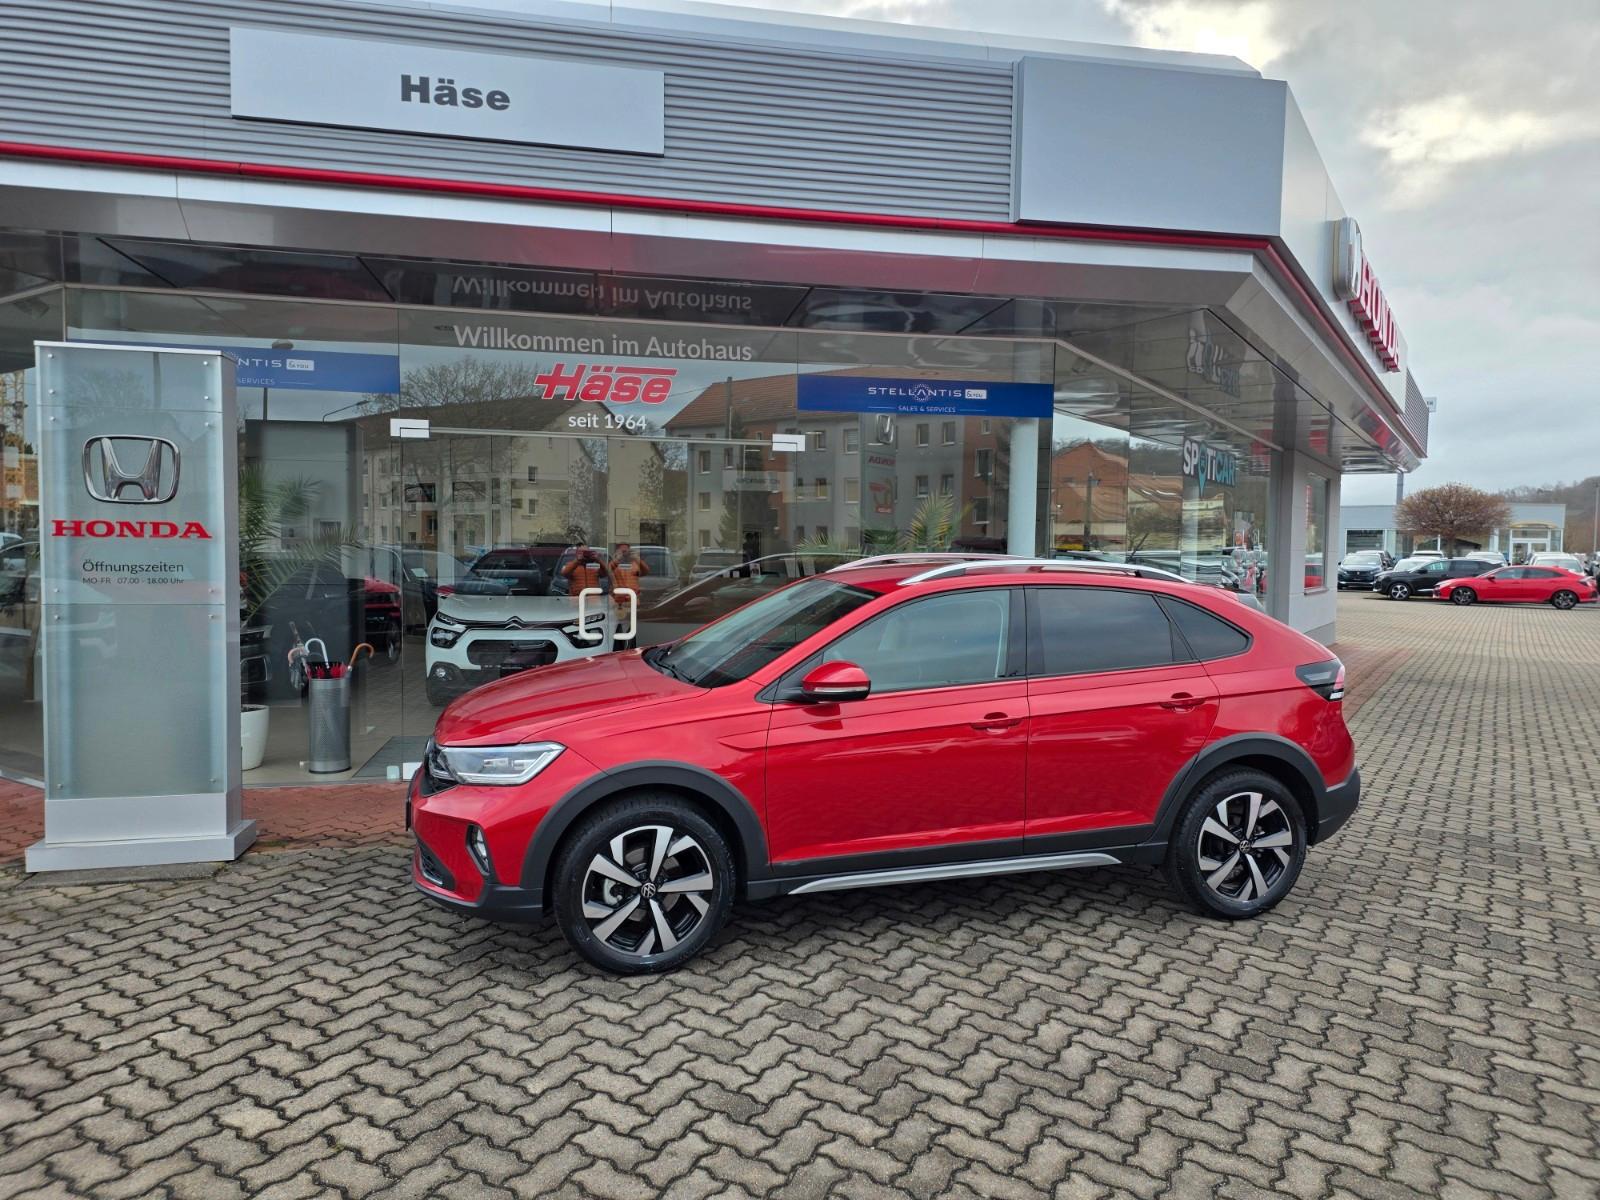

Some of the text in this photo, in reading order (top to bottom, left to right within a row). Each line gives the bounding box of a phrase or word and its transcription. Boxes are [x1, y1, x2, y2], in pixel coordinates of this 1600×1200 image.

[401, 74, 511, 111] Häse
[453, 325, 753, 361] Willkommen im Autohaus
[534, 362, 678, 404] Häse
[868, 386, 962, 398] STELLANTIS
[568, 413, 647, 430] seit 1964
[51, 520, 213, 539] HONDA
[82, 559, 184, 574] Öffnungszeiten
[170, 577, 184, 585] Uhr
